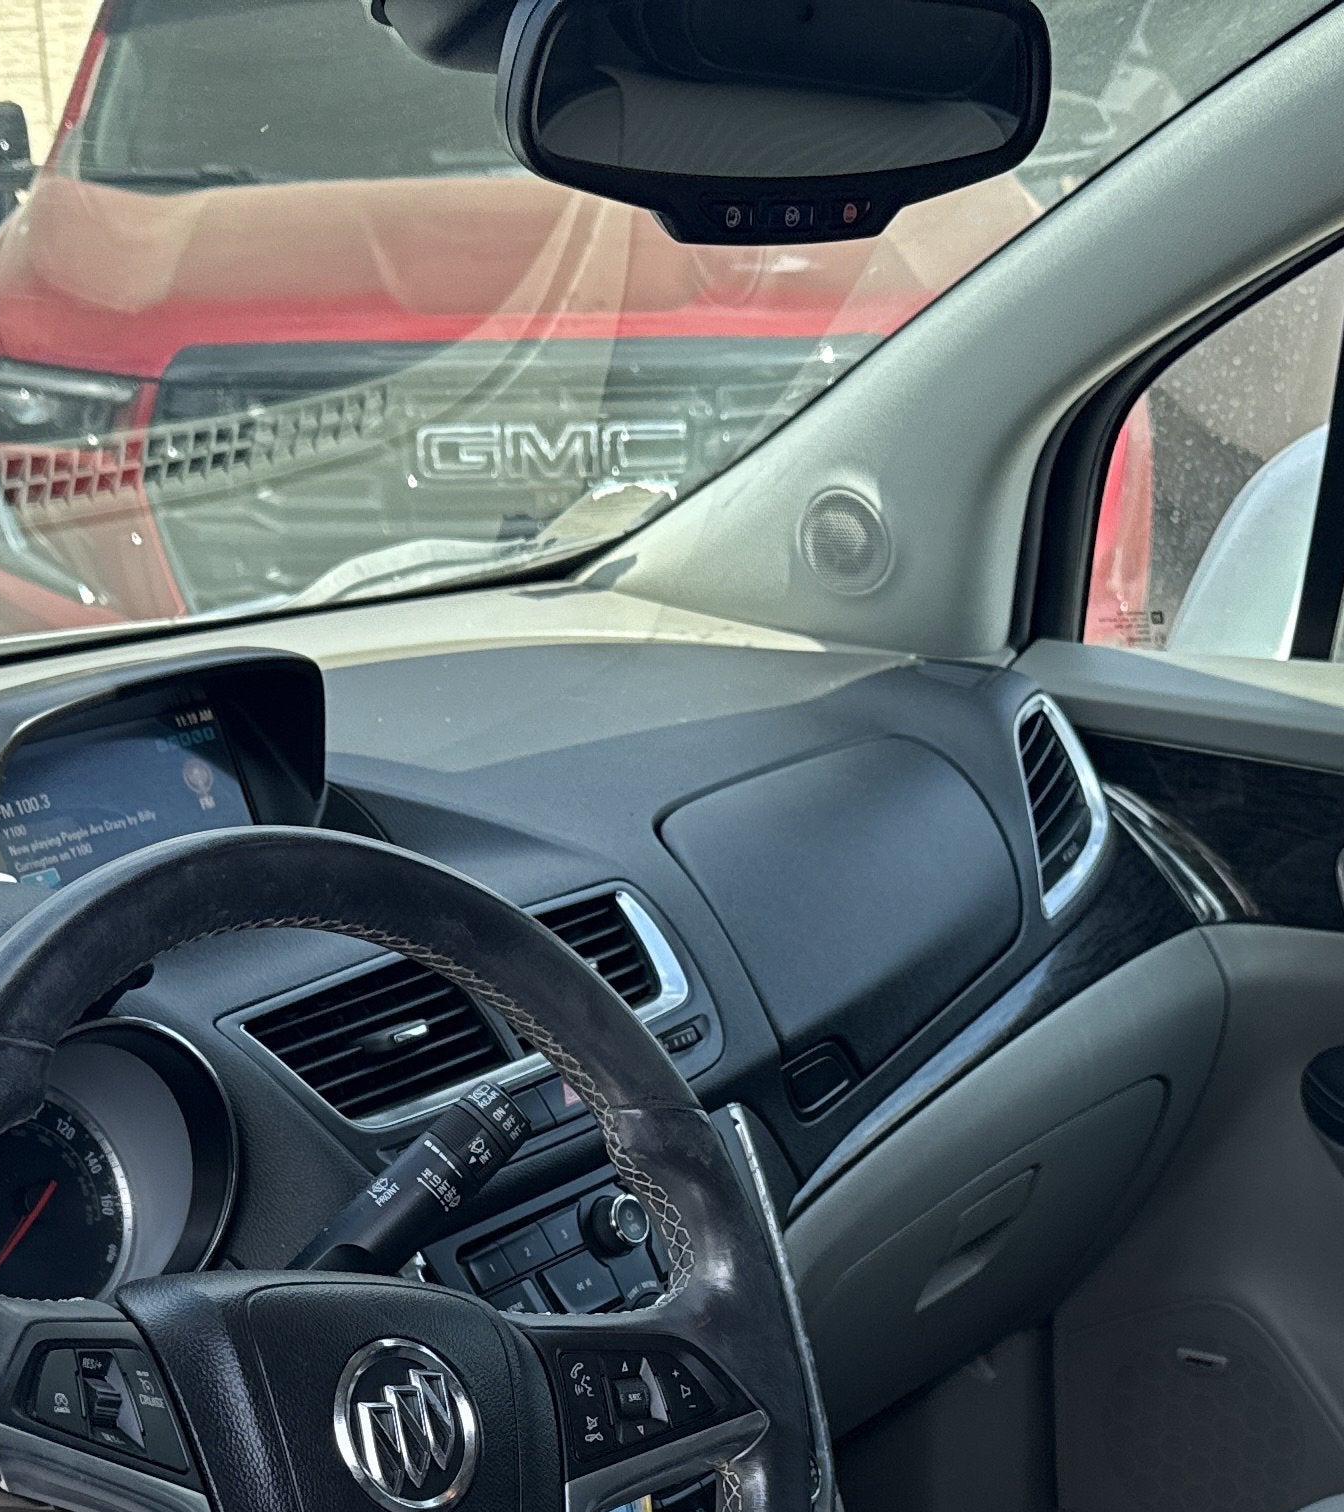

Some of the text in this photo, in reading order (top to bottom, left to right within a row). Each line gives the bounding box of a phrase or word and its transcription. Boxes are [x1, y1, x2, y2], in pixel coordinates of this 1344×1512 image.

[416, 420, 687, 485] GMC
[199, 709, 215, 722] AM
[15, 793, 52, 817] 100.3
[199, 796, 216, 811] FM
[1, 824, 28, 841] Y100
[8, 807, 158, 857] Now playing People Are Crazy by Billy
[14, 851, 59, 875] Currington
[70, 842, 94, 861] Y100
[478, 1089, 501, 1109] REAR
[492, 1107, 507, 1122] ON
[502, 1114, 517, 1132] OFF
[56, 1118, 76, 1141] 120
[509, 1126, 523, 1142] INT
[84, 1151, 103, 1174] 140
[479, 1149, 493, 1165] INT
[421, 1167, 433, 1180] HI
[429, 1174, 442, 1188] LO
[374, 1182, 401, 1207] FRONT
[436, 1179, 451, 1196] INT
[443, 1186, 457, 1203] OFF
[100, 1193, 114, 1217] 160
[561, 1229, 569, 1240] 3
[524, 1247, 532, 1257] 2
[488, 1263, 496, 1273] 1
